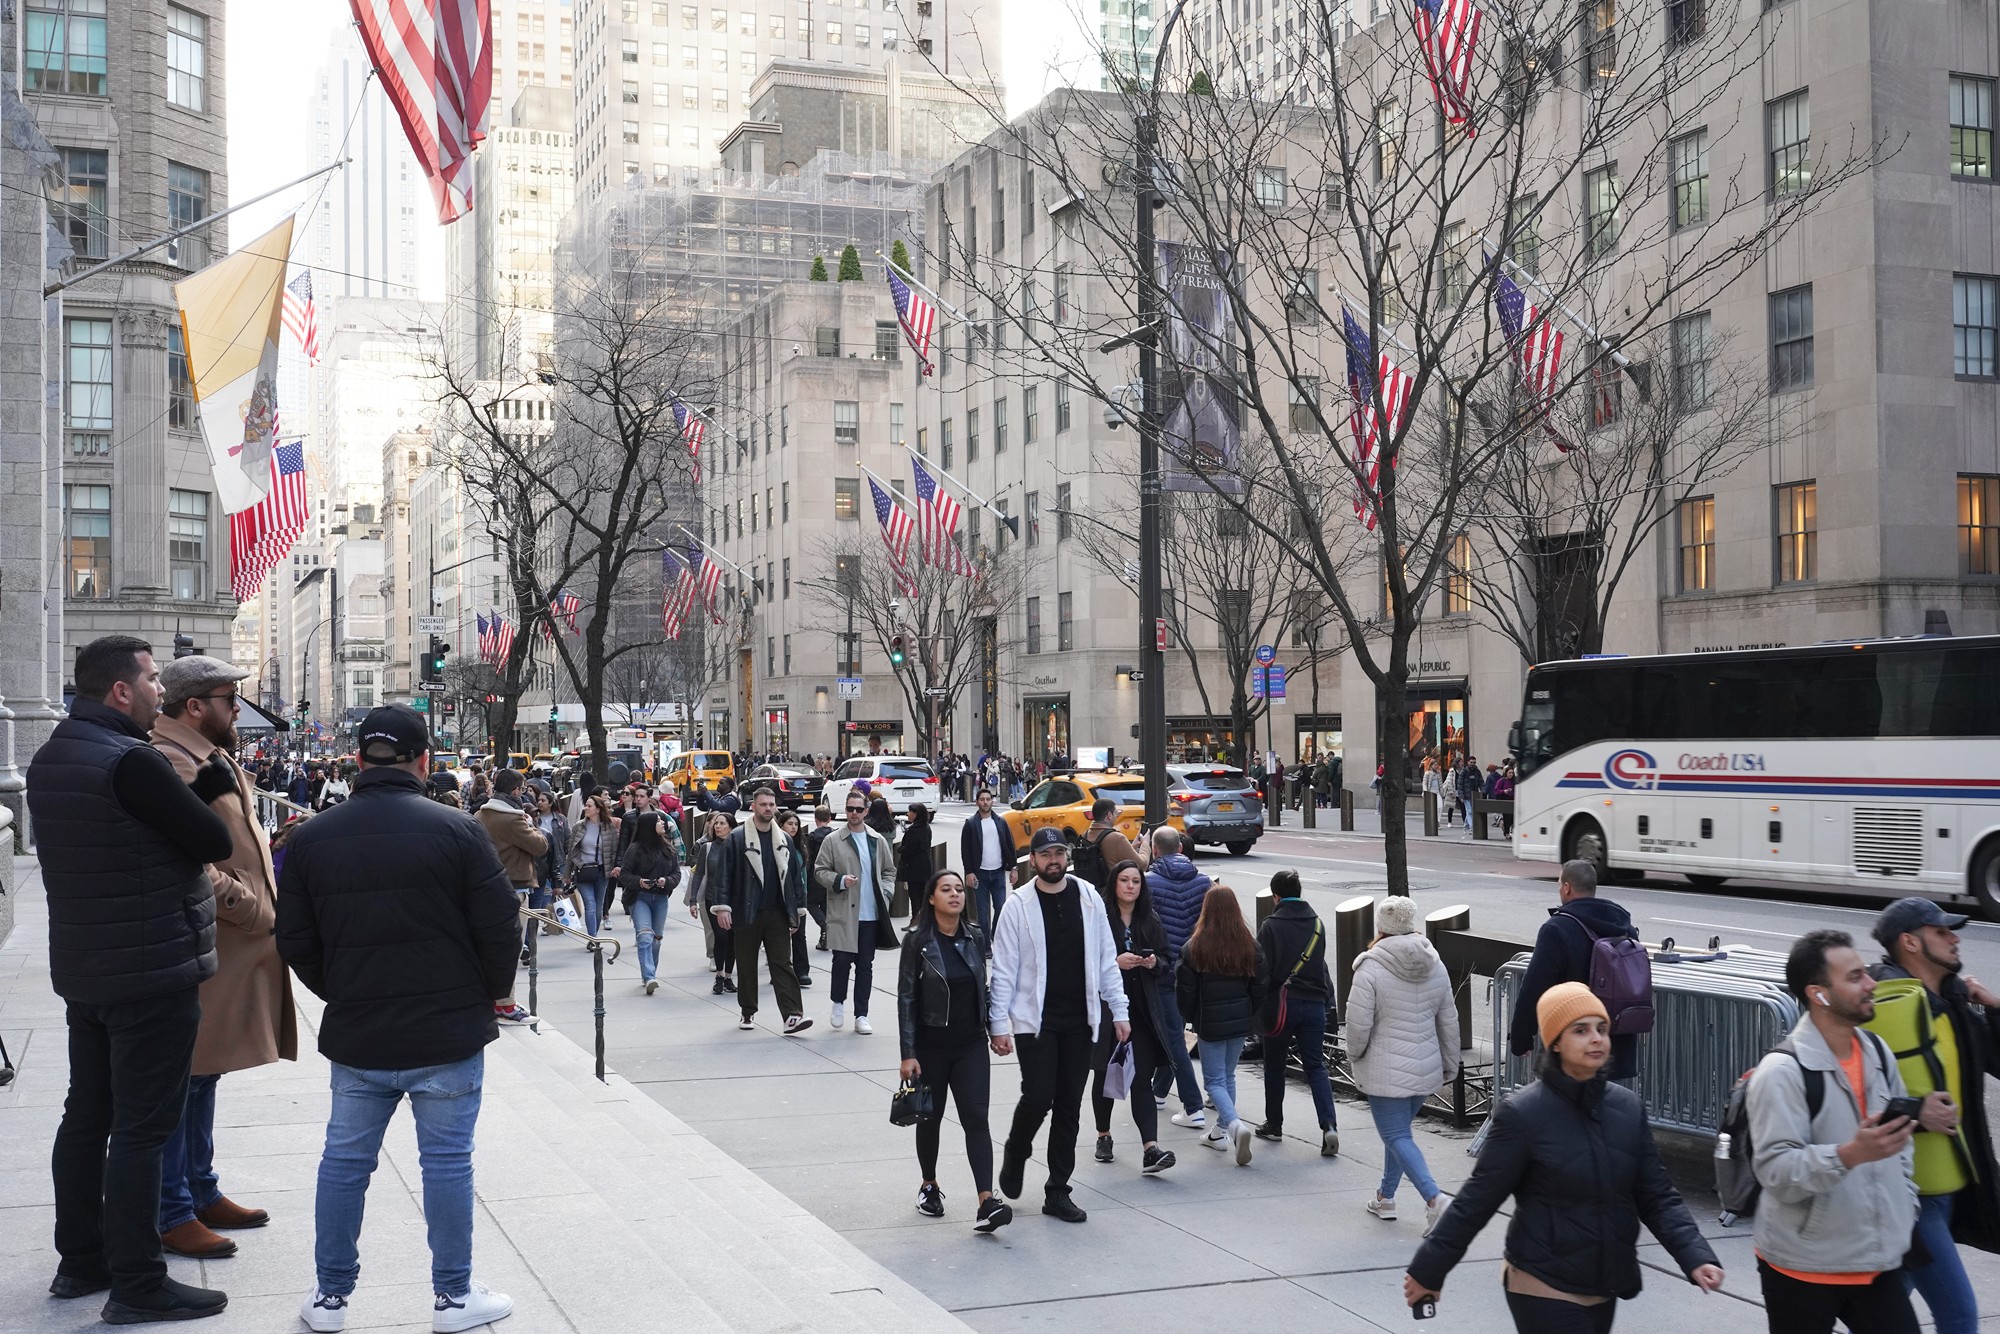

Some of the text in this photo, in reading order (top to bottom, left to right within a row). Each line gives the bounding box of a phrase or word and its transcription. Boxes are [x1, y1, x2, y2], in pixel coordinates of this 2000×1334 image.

[1185, 260, 1211, 276] LIVE
[1174, 272, 1221, 291] STREAM
[1420, 661, 1451, 672] REPUBLIC
[386, 733, 399, 742] Jeans
[1678, 753, 1766, 771] Coach USA
